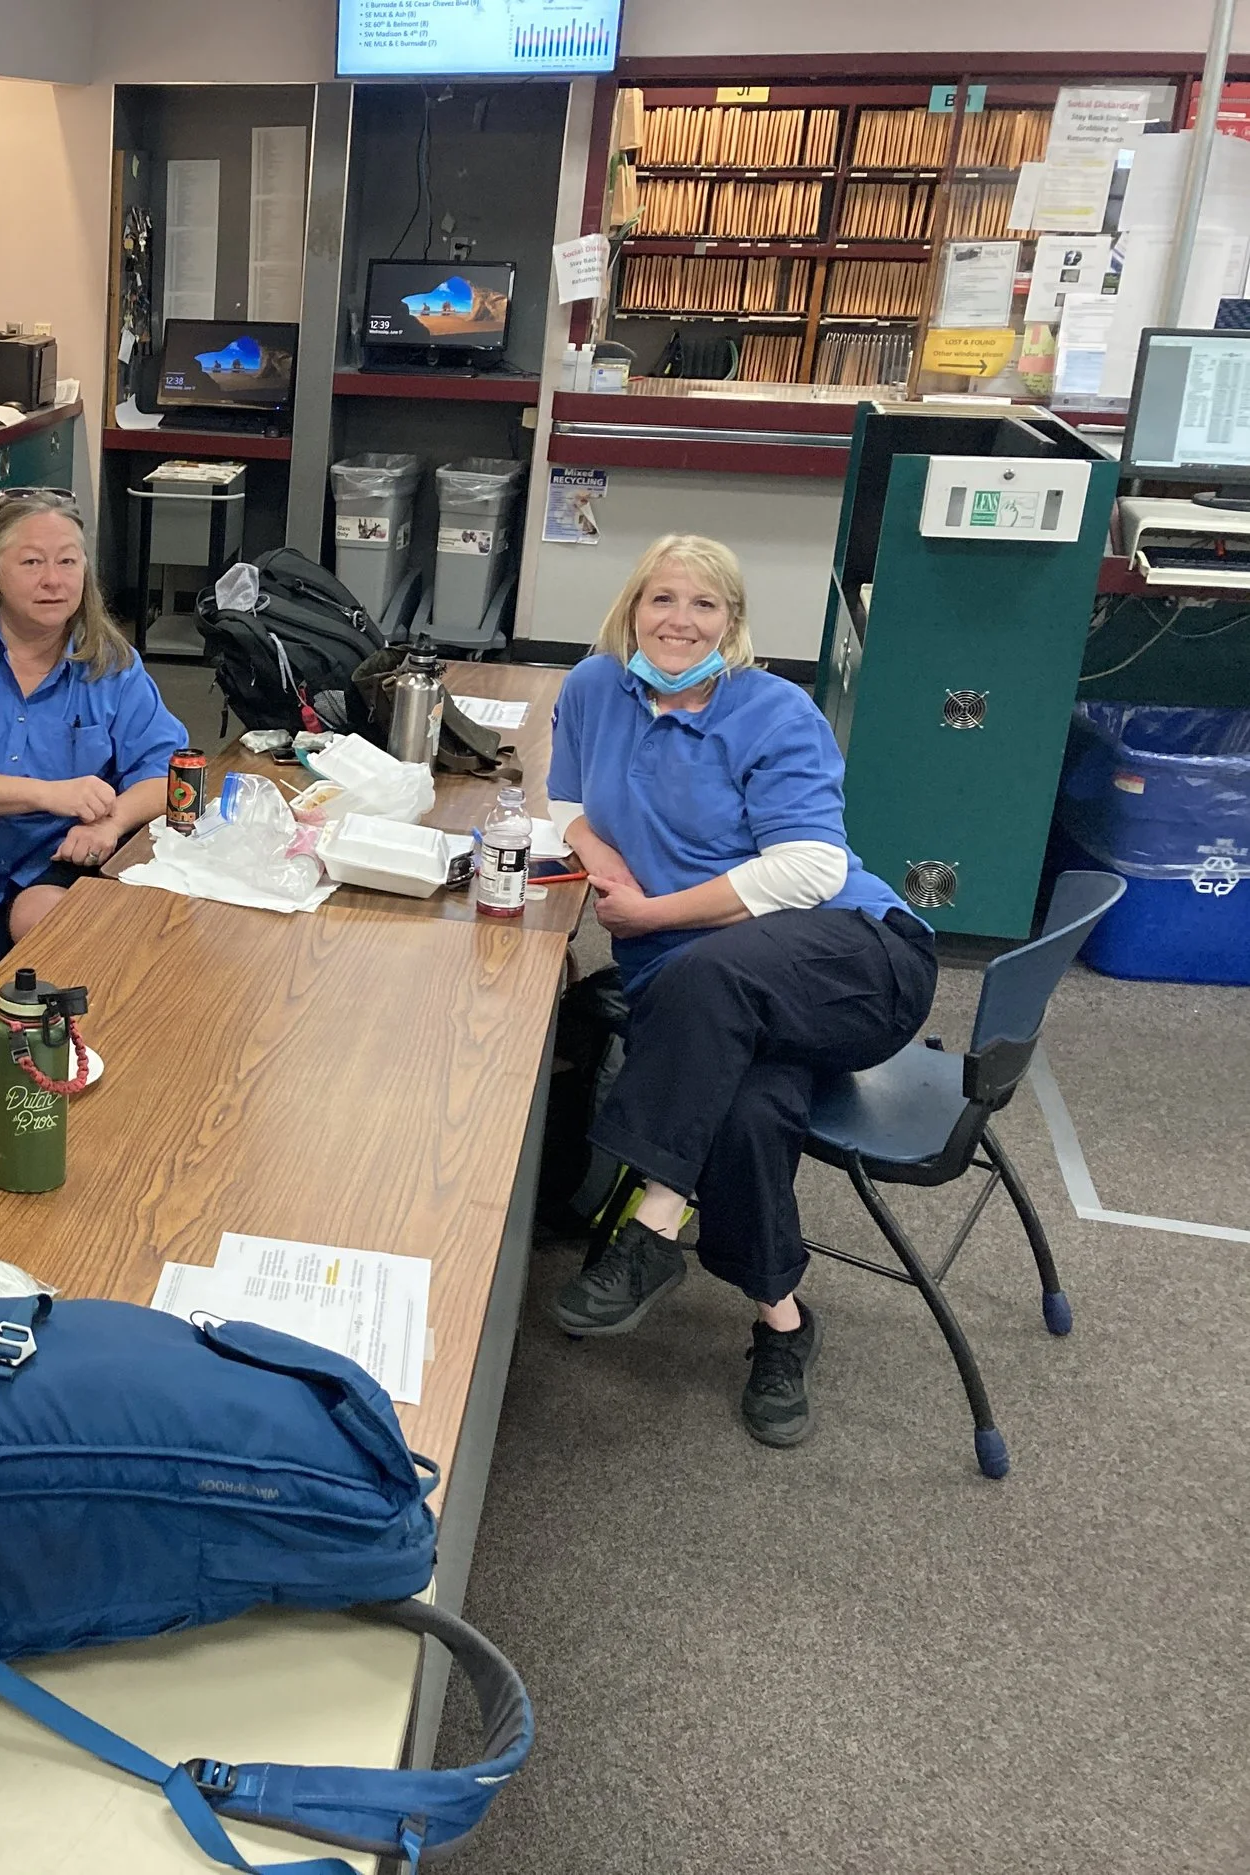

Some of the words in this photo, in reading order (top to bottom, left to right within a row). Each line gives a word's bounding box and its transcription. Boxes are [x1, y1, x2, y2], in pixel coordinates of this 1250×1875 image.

[562, 249, 583, 258] Social
[371, 321, 390, 329] 12:39
[166, 377, 184, 385] 12:38
[565, 468, 594, 477] Mixed
[553, 476, 604, 486] RECYCLING
[974, 493, 1000, 511] LENS
[1197, 845, 1249, 856] RECYCLE
[5, 1085, 62, 1112] Dutch
